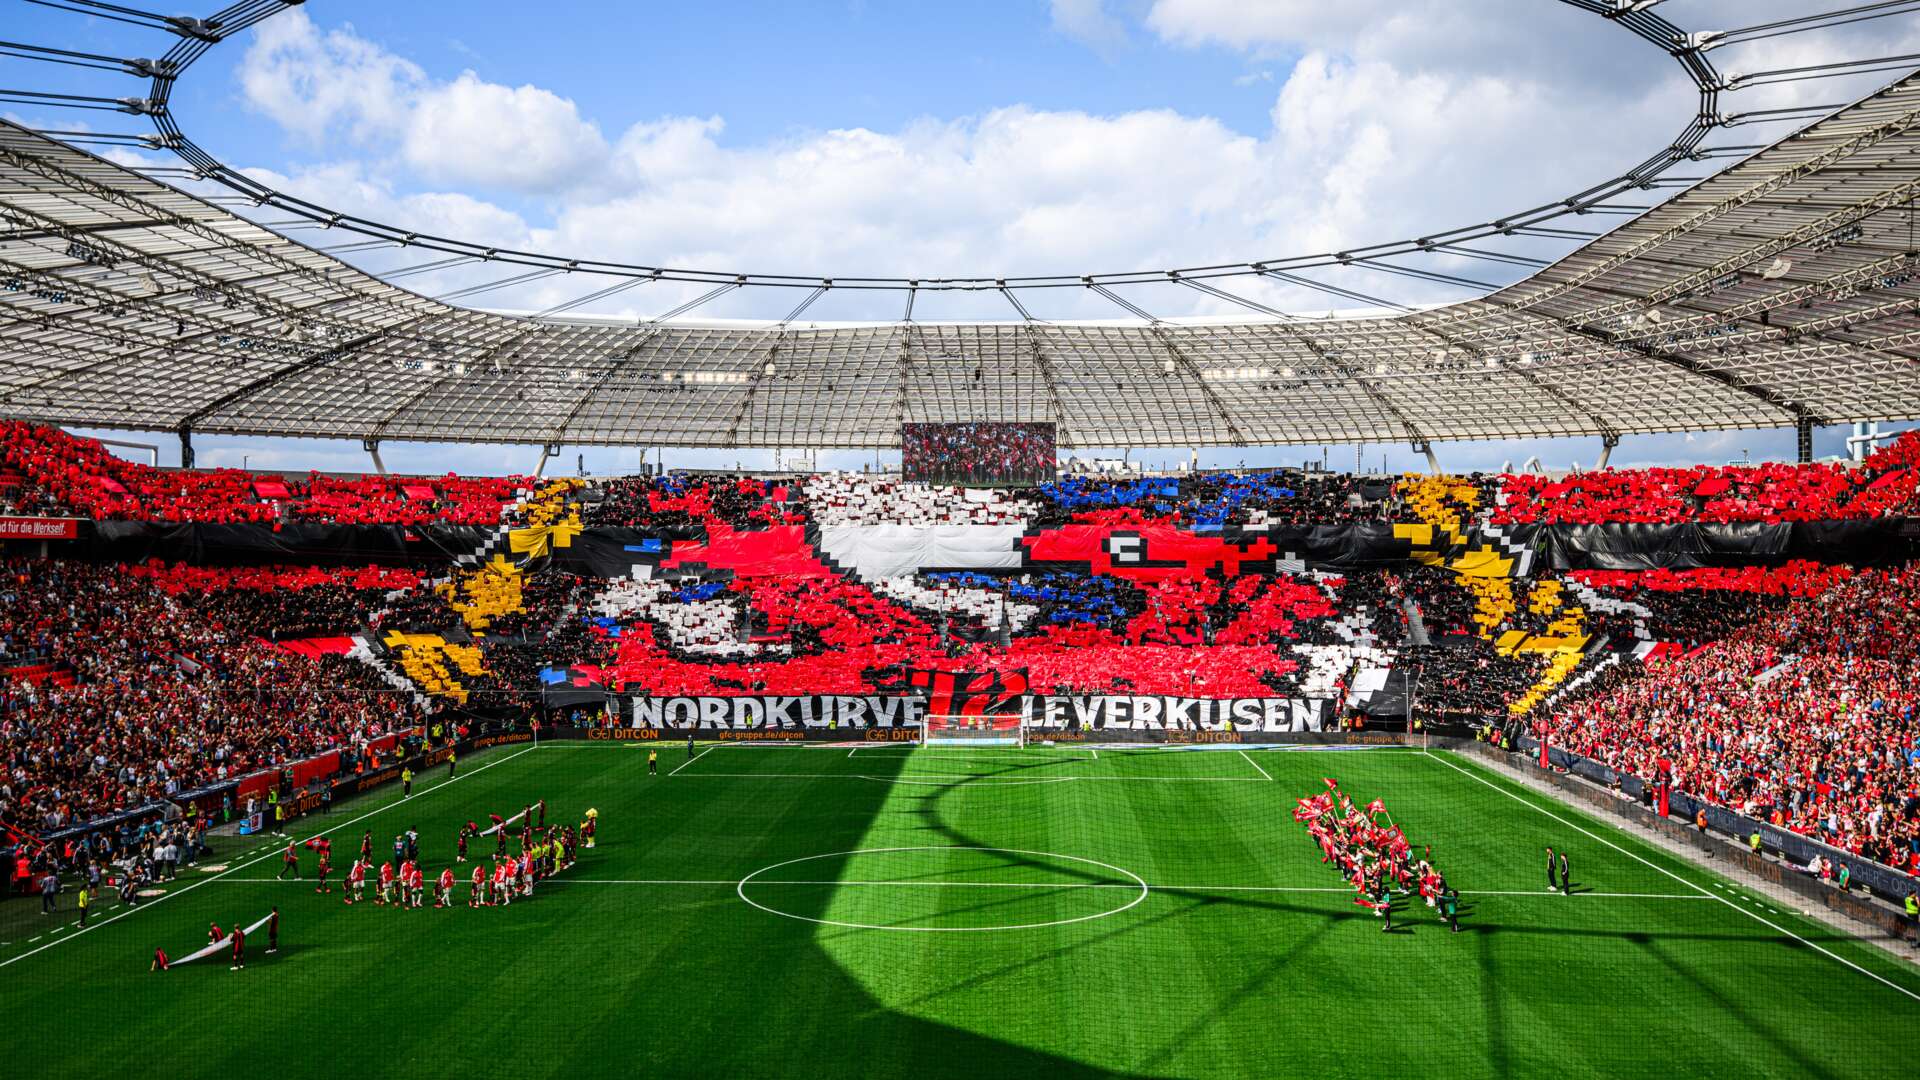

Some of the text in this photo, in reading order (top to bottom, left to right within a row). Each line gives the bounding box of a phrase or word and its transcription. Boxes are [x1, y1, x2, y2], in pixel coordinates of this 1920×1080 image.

[8, 520, 20, 533] für
[20, 521, 32, 533] die
[33, 521, 66, 536] Werkself.
[911, 670, 1027, 731] 12
[632, 695, 928, 729] NORDKURVE
[1021, 695, 1323, 732] LEVERKUSEN
[614, 728, 659, 740] DITCON
[719, 731, 804, 741] gfc-gruppe.de/ditcon
[1196, 731, 1242, 743] DITCON
